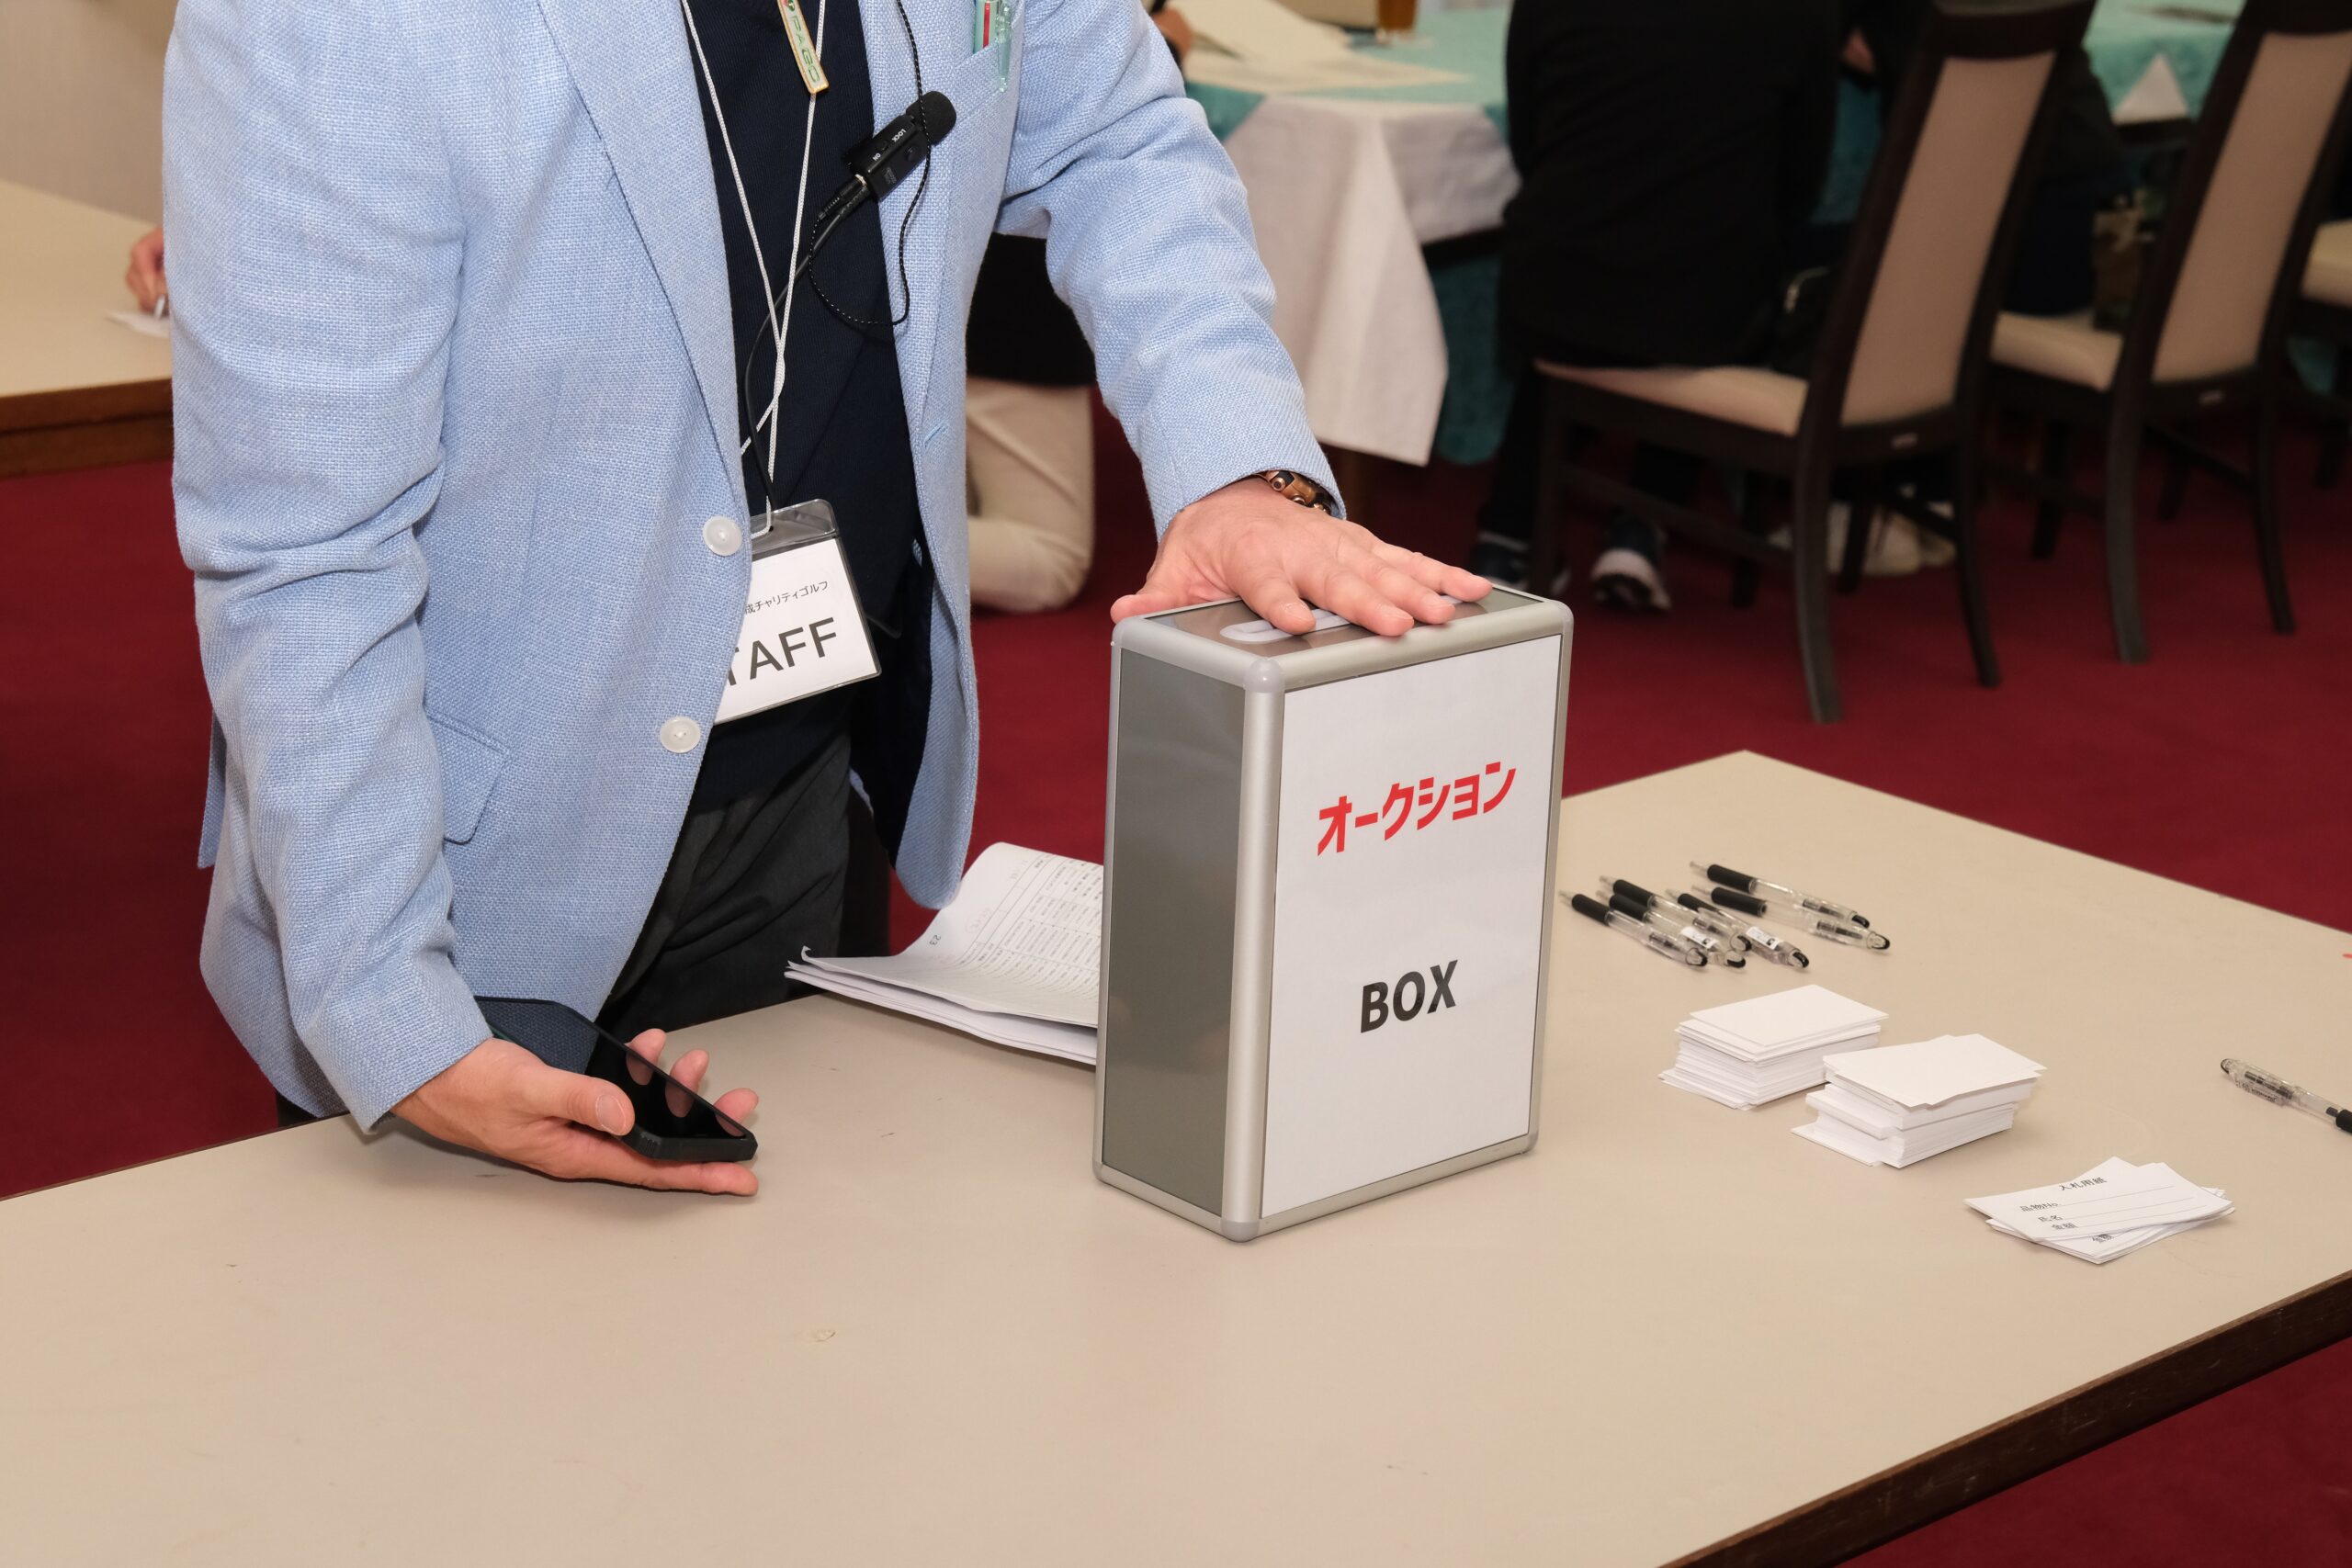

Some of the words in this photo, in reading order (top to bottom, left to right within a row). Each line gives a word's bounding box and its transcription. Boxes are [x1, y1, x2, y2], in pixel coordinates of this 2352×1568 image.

[891, 129, 907, 142] LOCK
[872, 152, 881, 162] ON
[1317, 761, 1516, 857] オークション
[929, 934, 942, 945] 23
[1361, 959, 1458, 1033] BOX
[2060, 1177, 2108, 1191] 入札用紙
